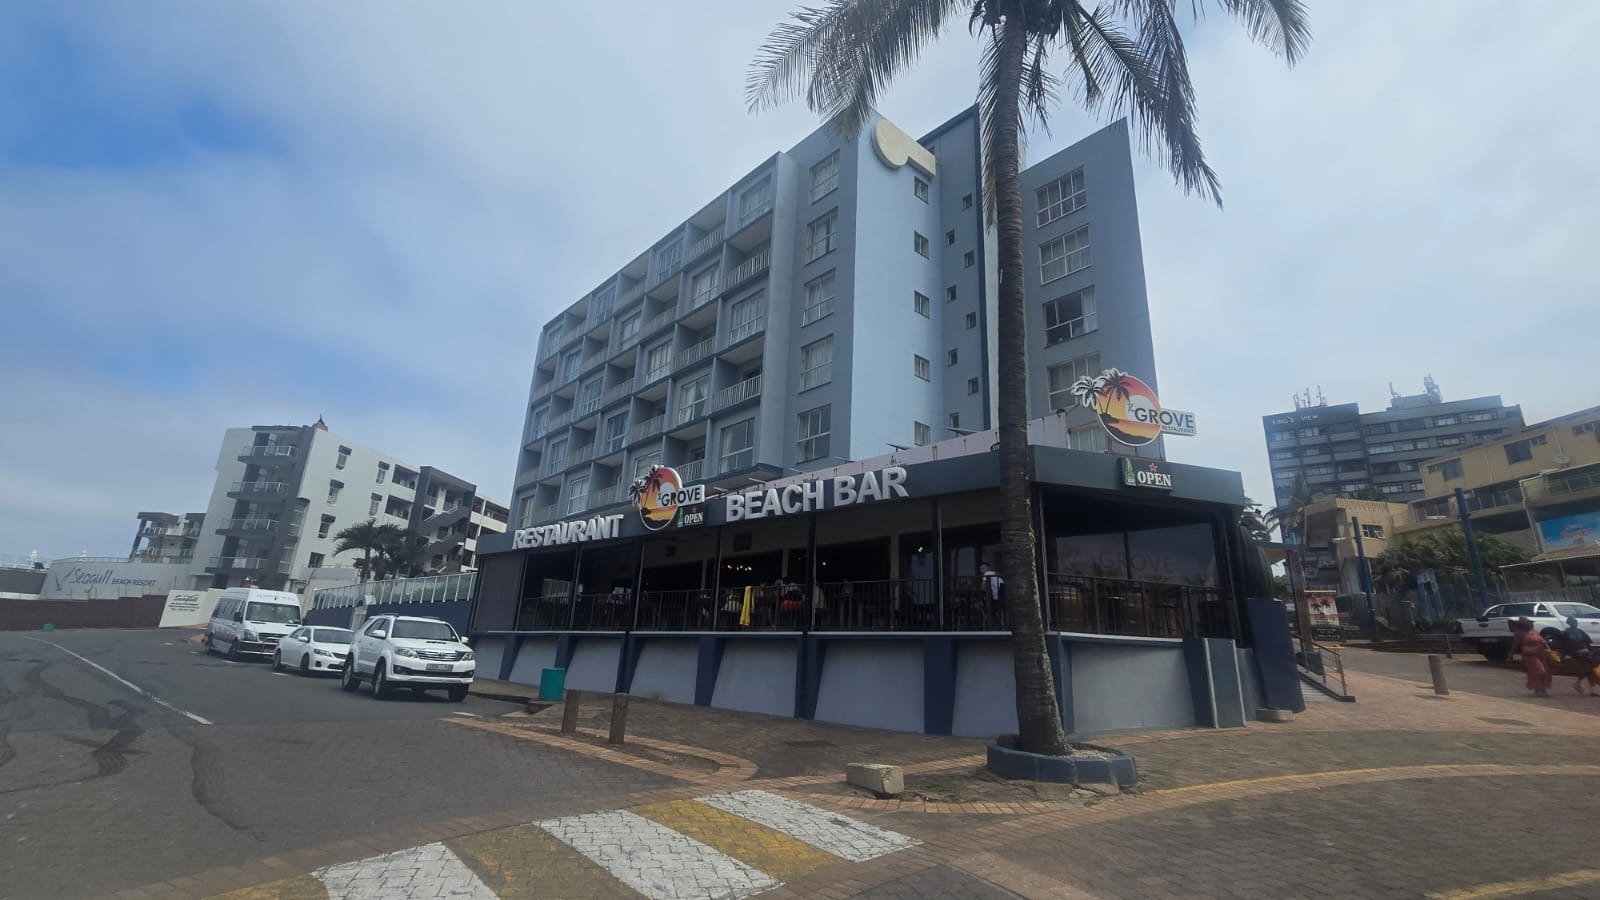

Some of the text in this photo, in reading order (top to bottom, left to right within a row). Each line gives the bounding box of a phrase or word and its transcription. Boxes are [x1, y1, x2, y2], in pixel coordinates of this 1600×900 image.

[1134, 407, 1194, 429] GROVE
[1137, 470, 1172, 487] OPEN
[661, 487, 701, 507] GROVE
[726, 466, 909, 523] BEACH BAR
[684, 512, 703, 524] OPEN
[511, 514, 624, 550] RESTAURANT
[69, 568, 114, 593] Seagull
